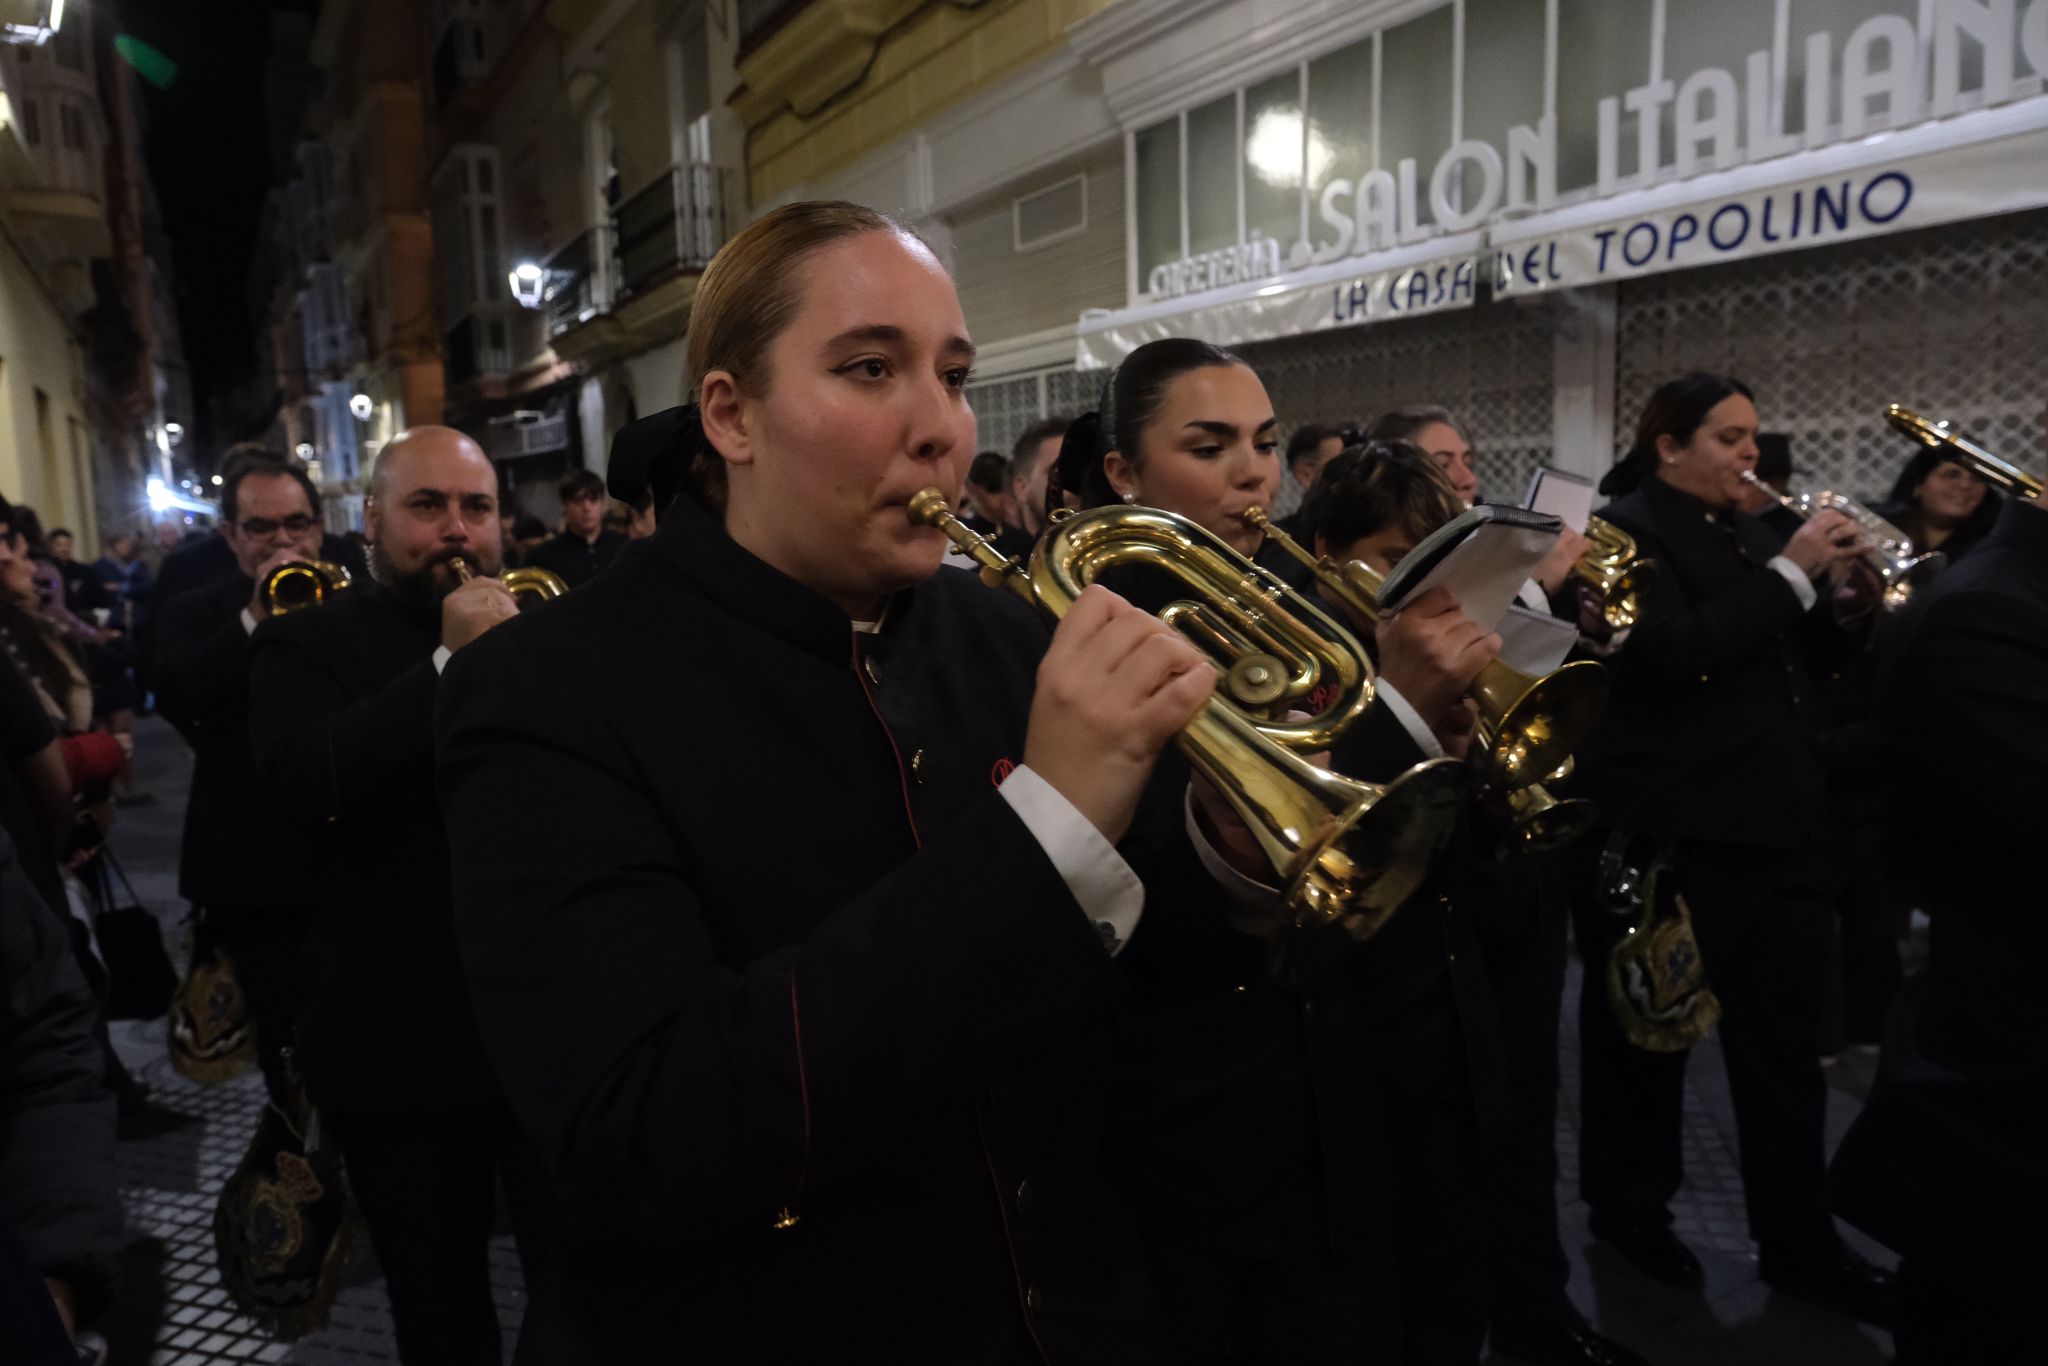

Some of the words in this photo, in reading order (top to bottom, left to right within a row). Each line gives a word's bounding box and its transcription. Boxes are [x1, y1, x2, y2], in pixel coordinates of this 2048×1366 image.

[1597, 0, 2048, 195] ITALIAN
[1333, 282, 1368, 321] LA
[1388, 260, 1472, 310] CASA
[1594, 172, 1913, 272] TOPOLINO
